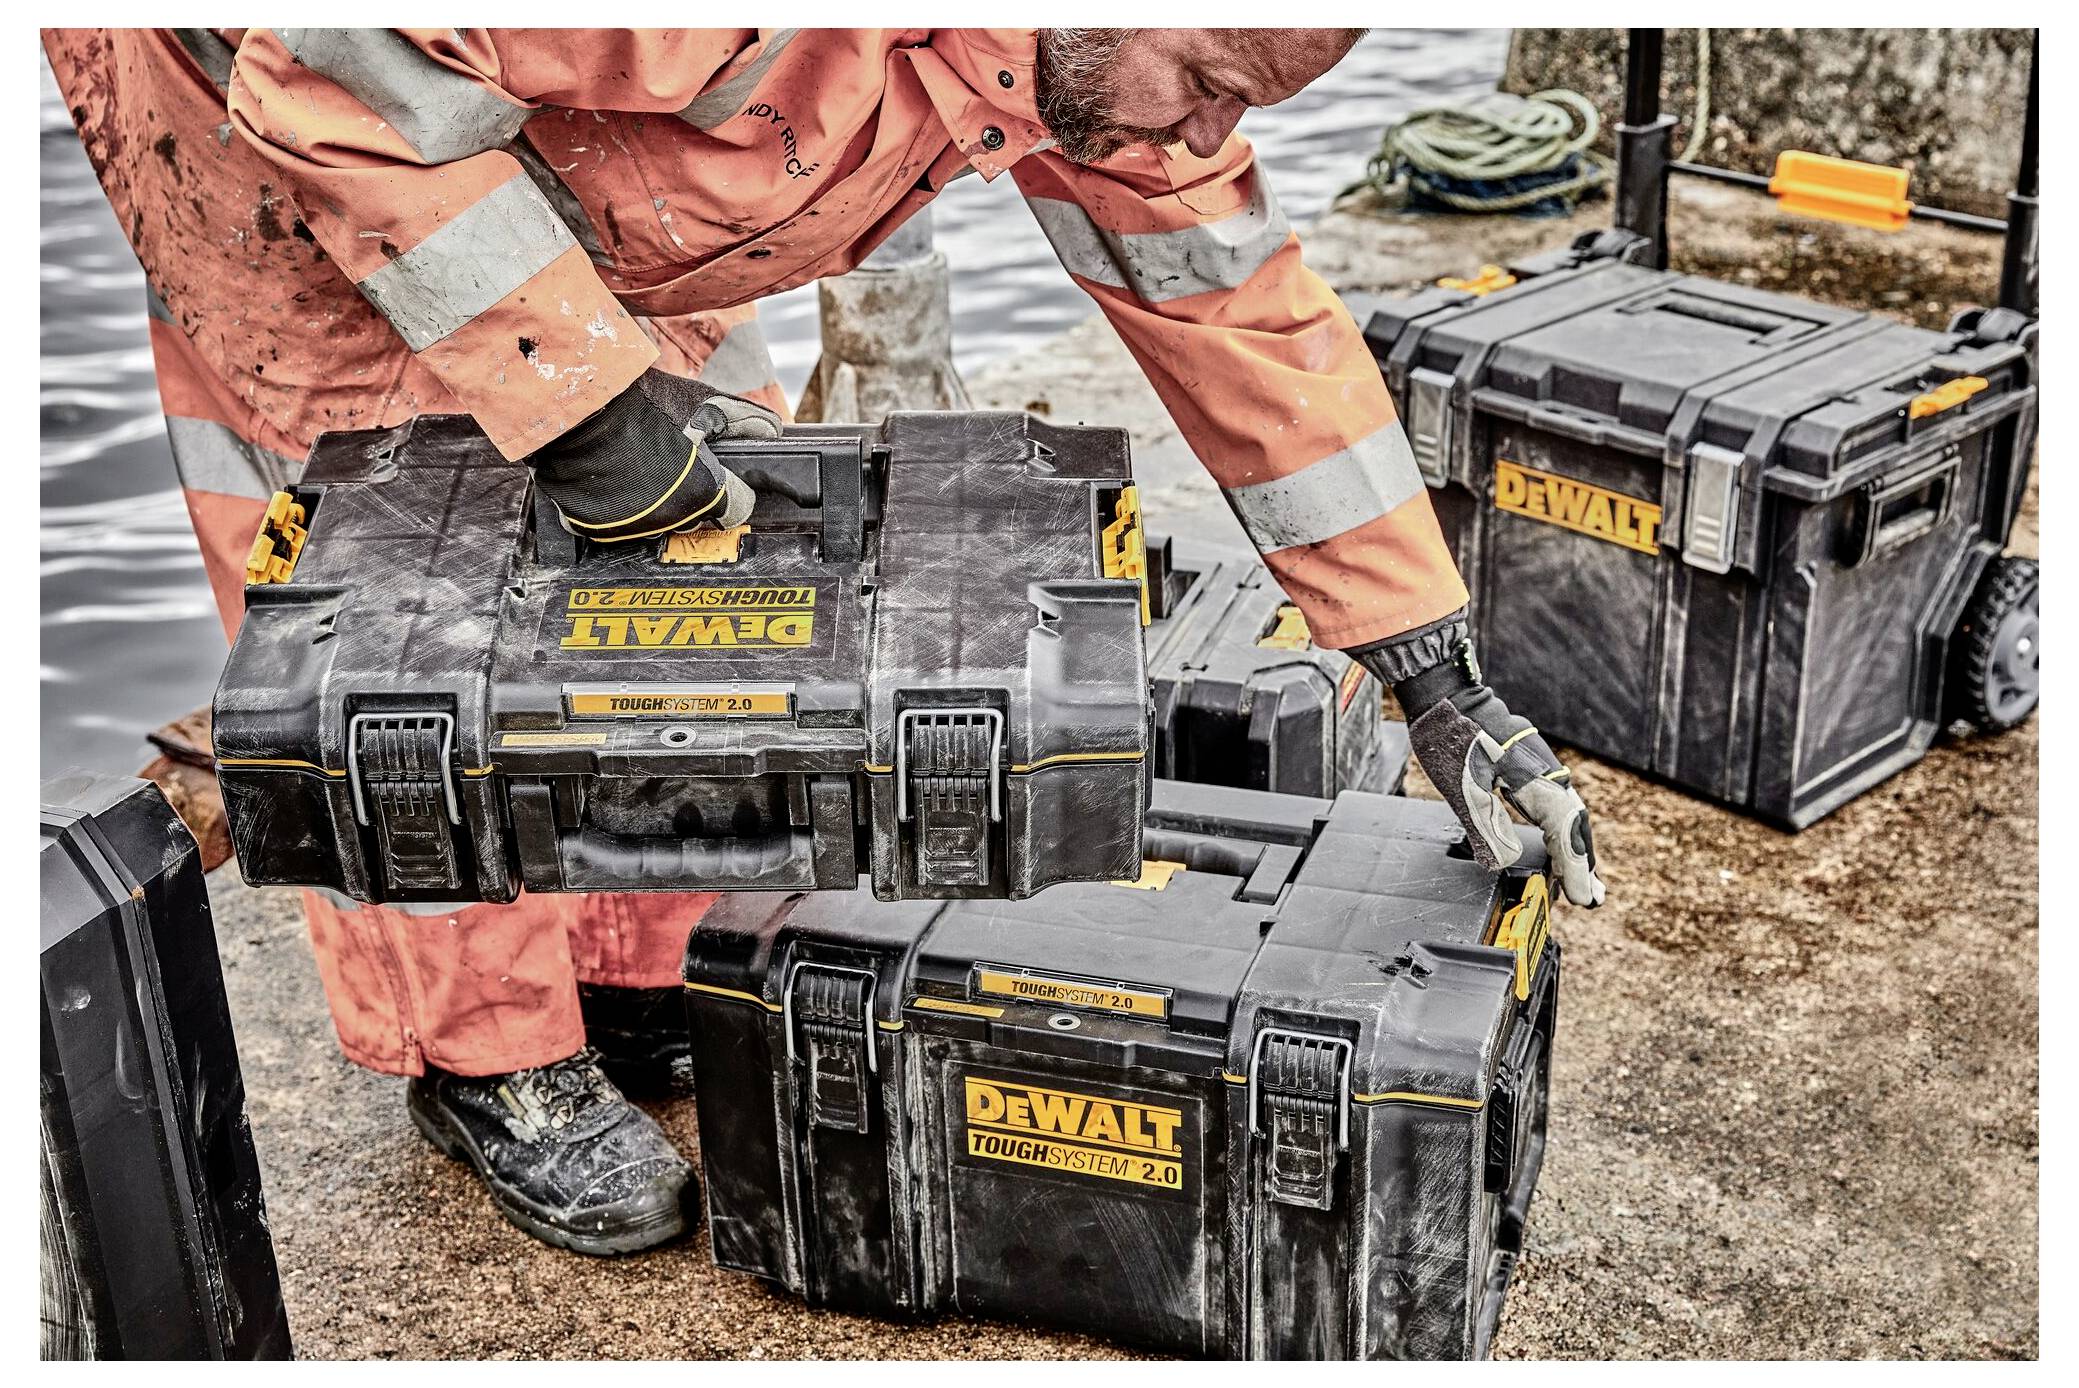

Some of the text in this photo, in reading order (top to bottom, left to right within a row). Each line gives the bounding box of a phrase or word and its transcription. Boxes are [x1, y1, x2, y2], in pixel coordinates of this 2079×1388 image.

[1496, 466, 1661, 548] DEWALT
[574, 589, 813, 606] TOUGHSYSTEM 2.0
[562, 615, 813, 646] DEWALT
[610, 697, 753, 711] TOUGHSYSTEM 2.0
[1011, 980, 1133, 1009] TOUGHSYSTEM 2.0
[965, 1082, 1182, 1151] DEWALT
[972, 1133, 1178, 1185] TOUGHSYSTEM 2.0
